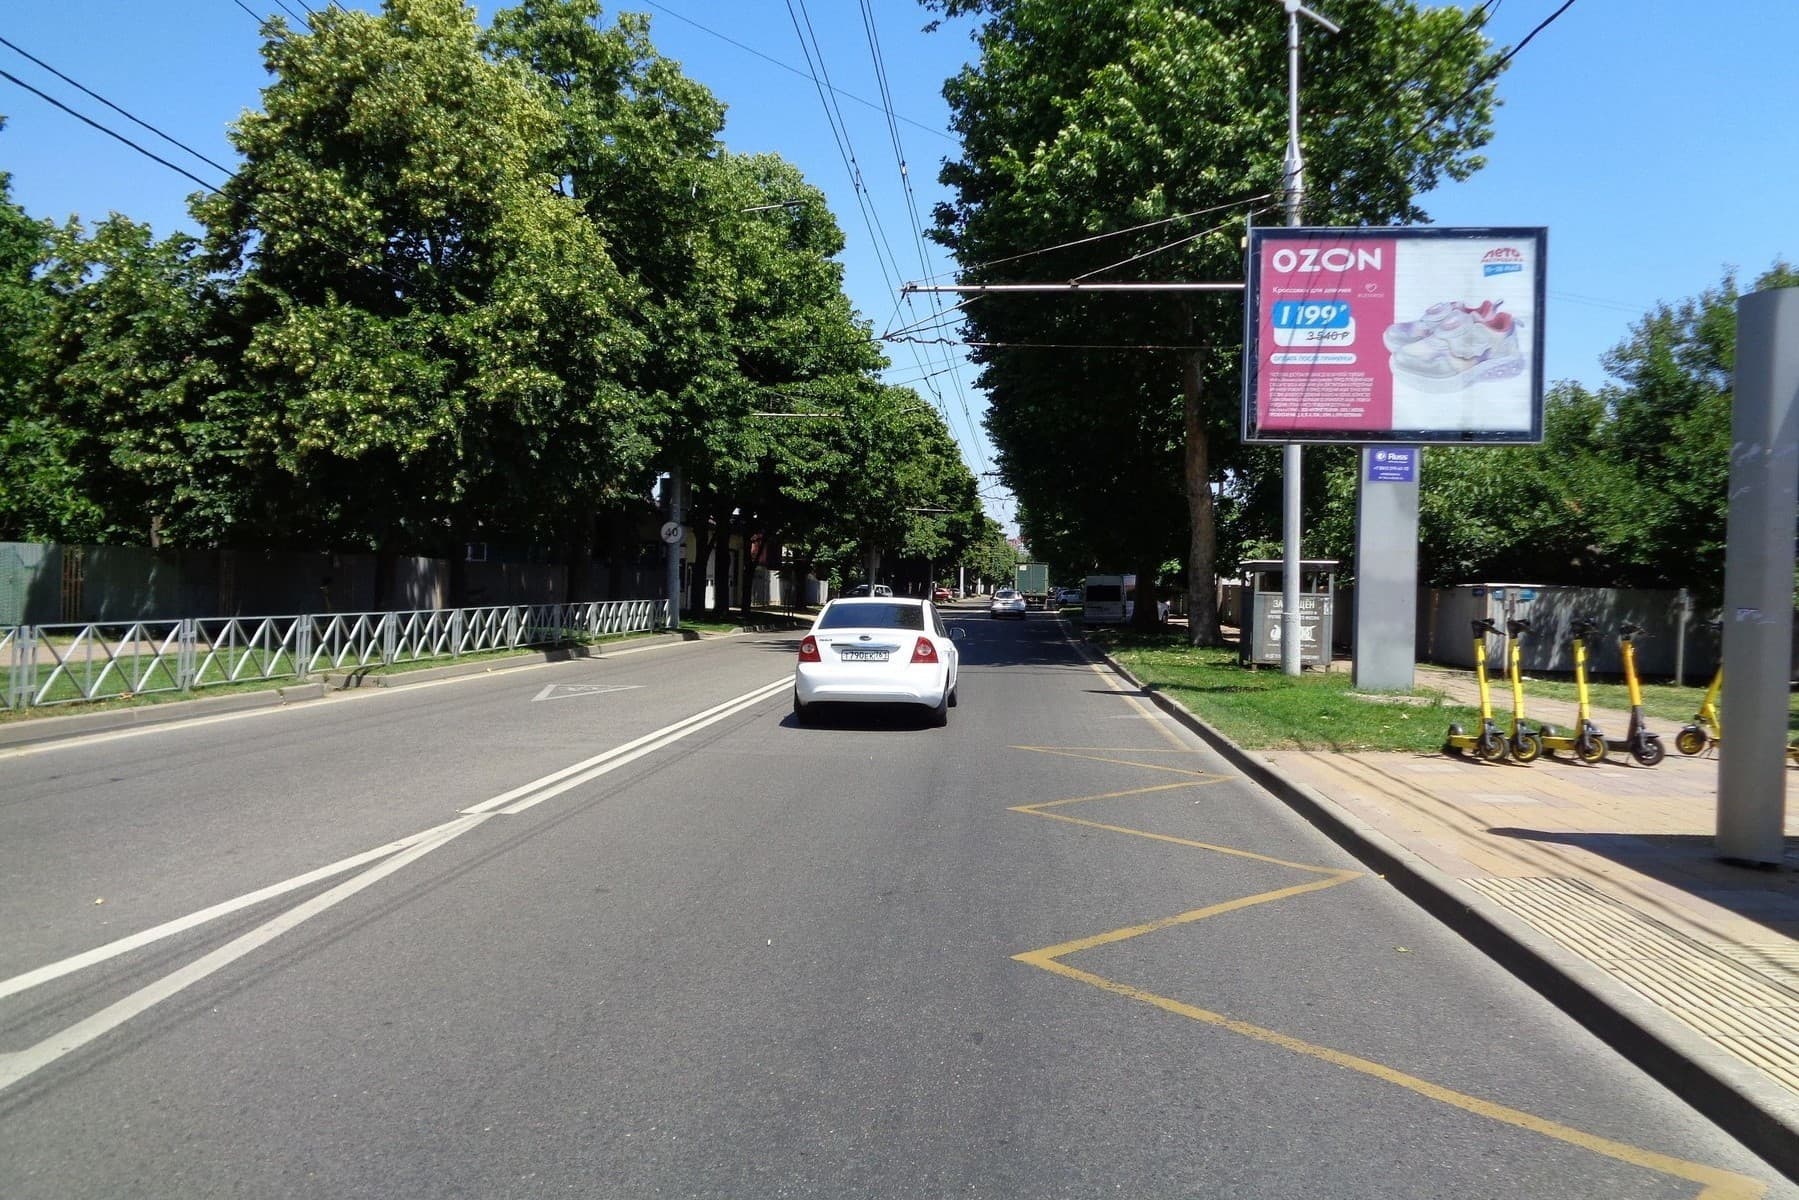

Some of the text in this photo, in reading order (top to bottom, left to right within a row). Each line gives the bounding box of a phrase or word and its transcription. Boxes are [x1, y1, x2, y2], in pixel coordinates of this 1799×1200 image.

[1272, 247, 1382, 273] OZON
[665, 527, 678, 537] 40
[1272, 598, 1315, 610] ЗАЩЁН
